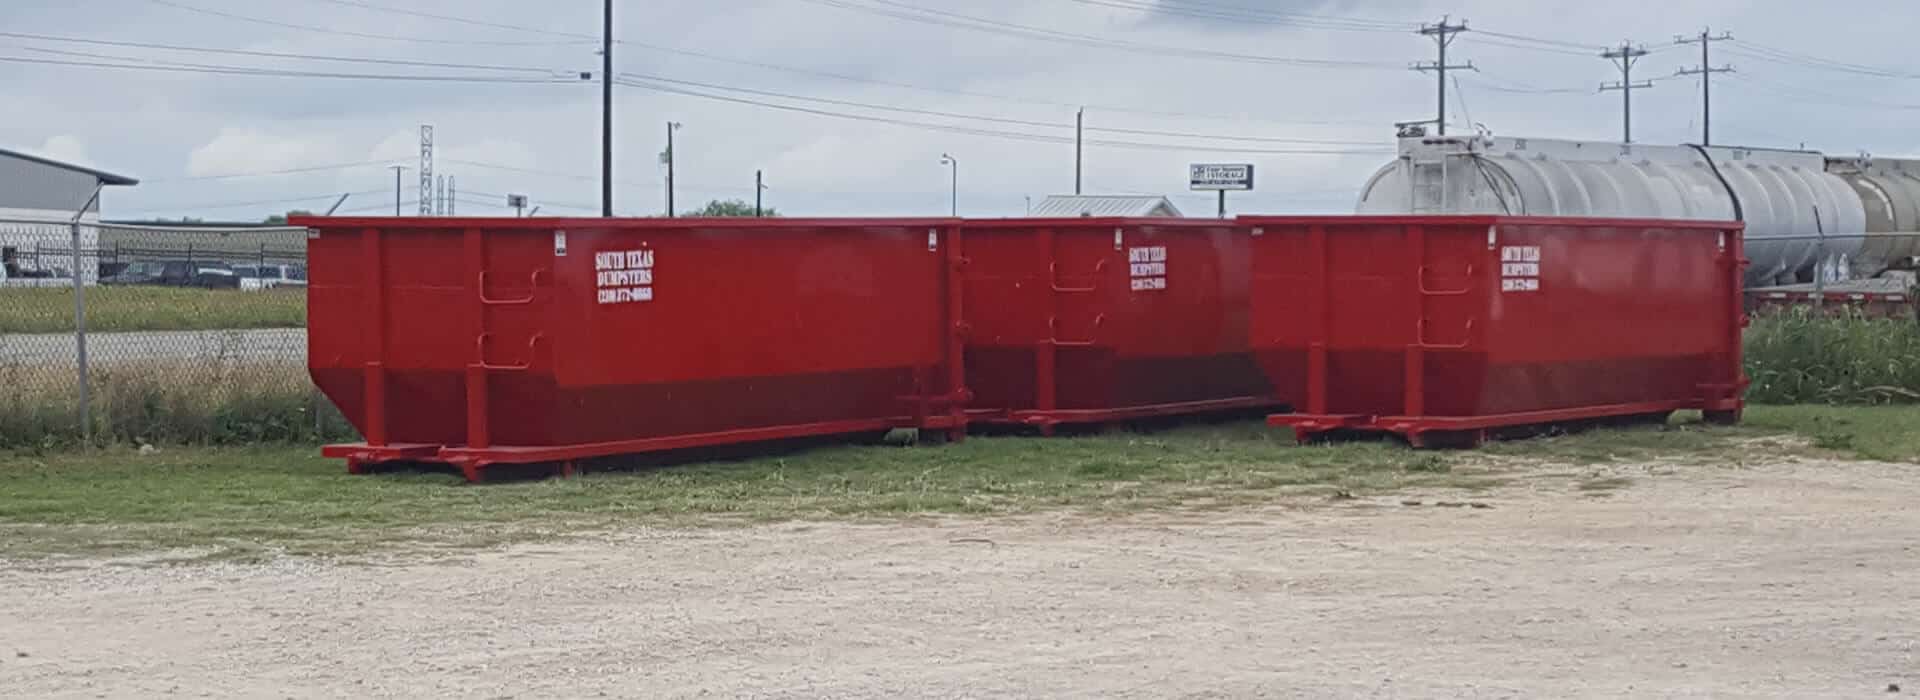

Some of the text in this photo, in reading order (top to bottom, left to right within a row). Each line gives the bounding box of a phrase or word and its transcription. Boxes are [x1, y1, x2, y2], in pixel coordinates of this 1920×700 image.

[596, 249, 654, 270] SOUTH TEXAS
[597, 269, 652, 287] DUMPSTERS
